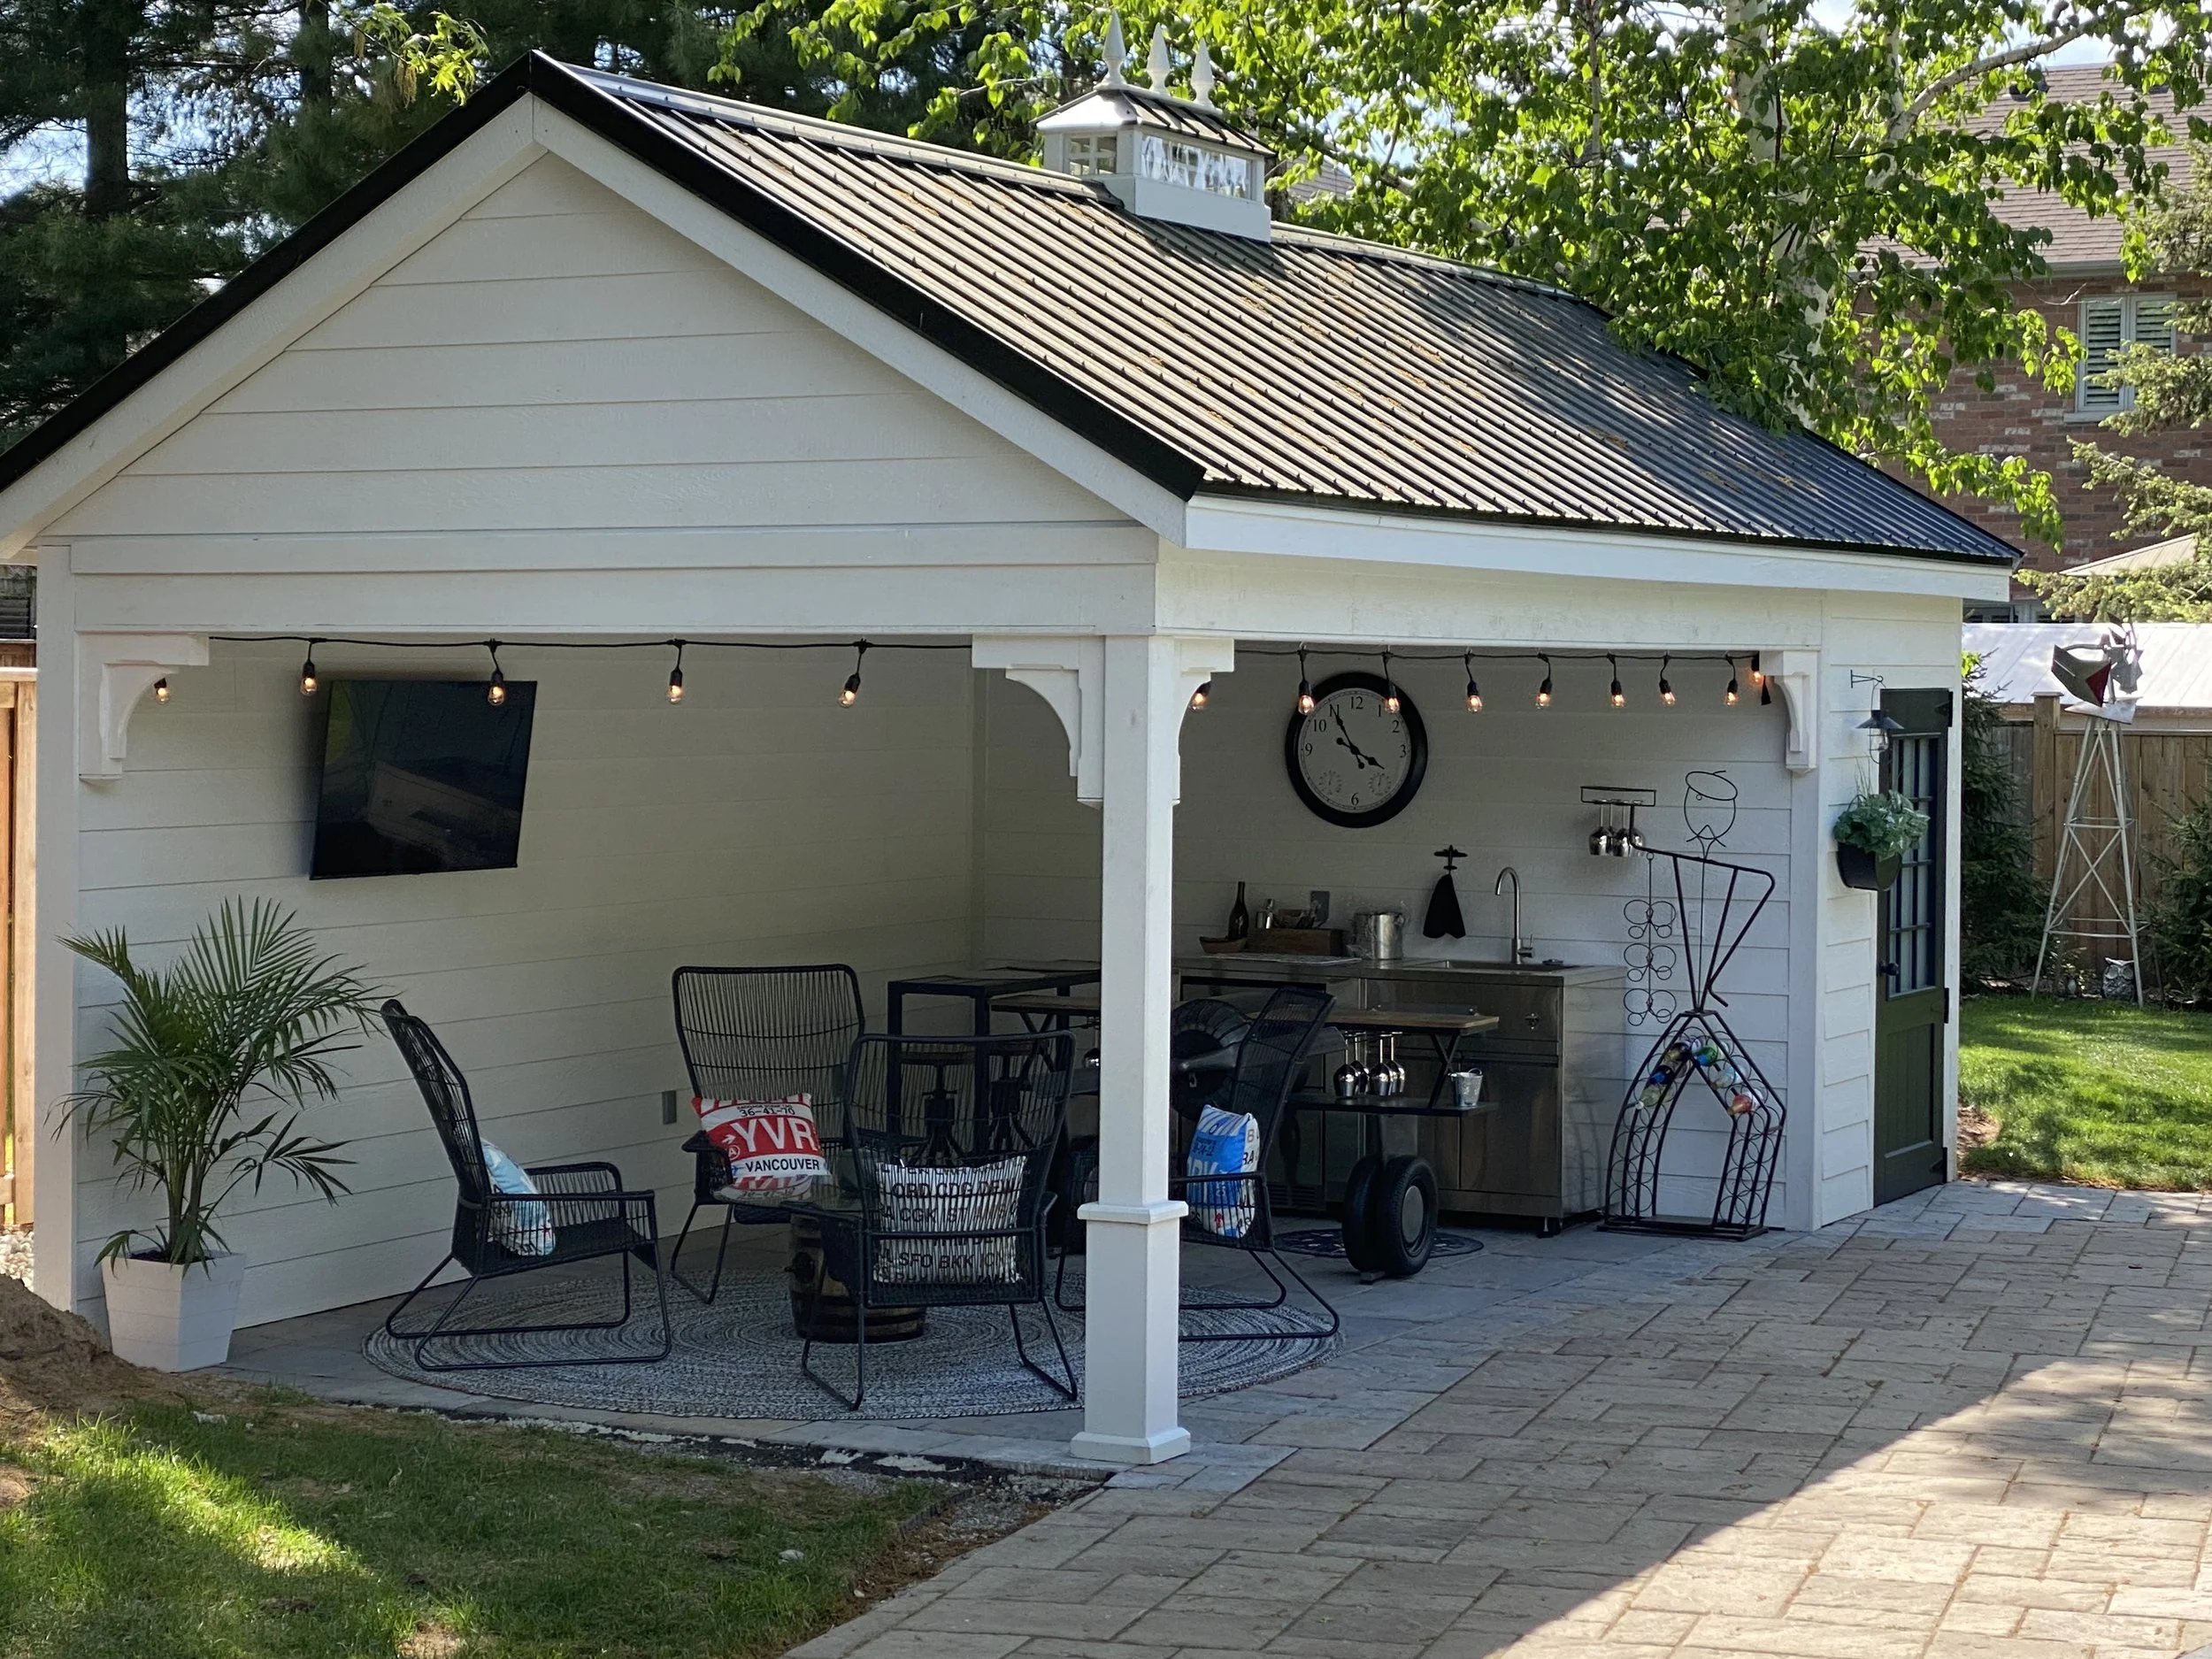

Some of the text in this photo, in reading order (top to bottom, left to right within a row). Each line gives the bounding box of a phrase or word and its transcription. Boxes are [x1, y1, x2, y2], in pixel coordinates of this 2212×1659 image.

[1350, 696, 1363, 710] 12
[1377, 704, 1382, 718] 1
[1313, 719, 1327, 733] 10
[1392, 719, 1400, 733] 2
[1304, 743, 1313, 757] 9
[1399, 744, 1407, 758] 3
[1350, 793, 1359, 806] 6
[739, 1107, 795, 1118] 36-41-70
[730, 1118, 818, 1153] YVR
[745, 1158, 820, 1172] VANCOUVER
